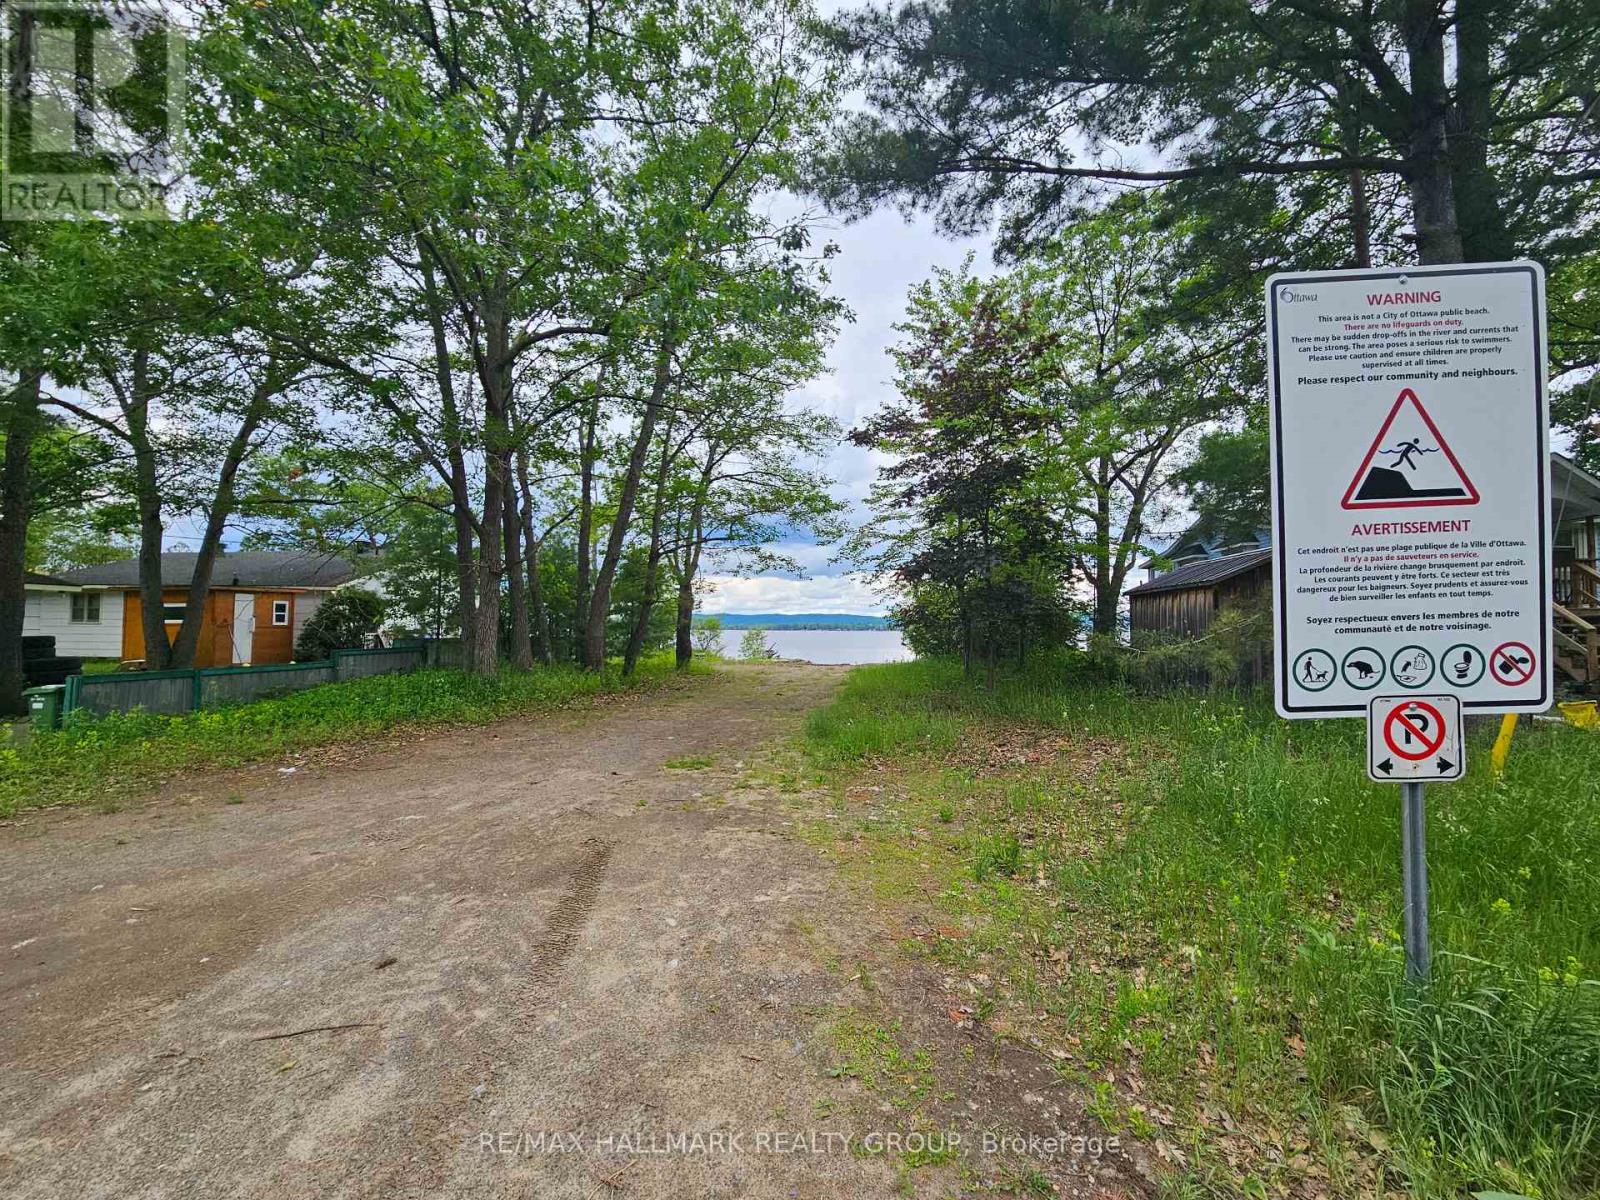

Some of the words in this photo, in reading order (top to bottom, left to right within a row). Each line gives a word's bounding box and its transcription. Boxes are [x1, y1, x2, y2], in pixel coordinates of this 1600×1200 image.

[1366, 290, 1441, 306] WARNING
[1440, 308, 1463, 317] public
[1393, 320, 1431, 328] lifeguards
[1445, 319, 1463, 328] duty.
[1372, 331, 1407, 340] drop-offs
[1386, 341, 1408, 349] poses
[1470, 346, 1502, 355] properly
[1362, 360, 1402, 368] supervised
[1330, 375, 1364, 384] respect
[1386, 371, 1438, 380] community
[1442, 370, 1459, 378] and
[1462, 368, 1518, 378] neighbours.
[1352, 520, 1470, 536] AVERTISSEMENT
[1415, 542, 1447, 551] publique
[1310, 566, 1351, 575] profondeur
[1400, 562, 1426, 571] change
[1362, 574, 1392, 582] peuvent
[1297, 586, 1336, 594] dangereux
[1370, 583, 1408, 592] baigneurs.
[1410, 582, 1432, 590] Soyez
[1434, 581, 1468, 589] prudents
[1307, 616, 1332, 625] Soyez
[1335, 615, 1388, 624] respectueux
[1334, 625, 1392, 634] communauté
[1446, 622, 1491, 631] voisinage.
